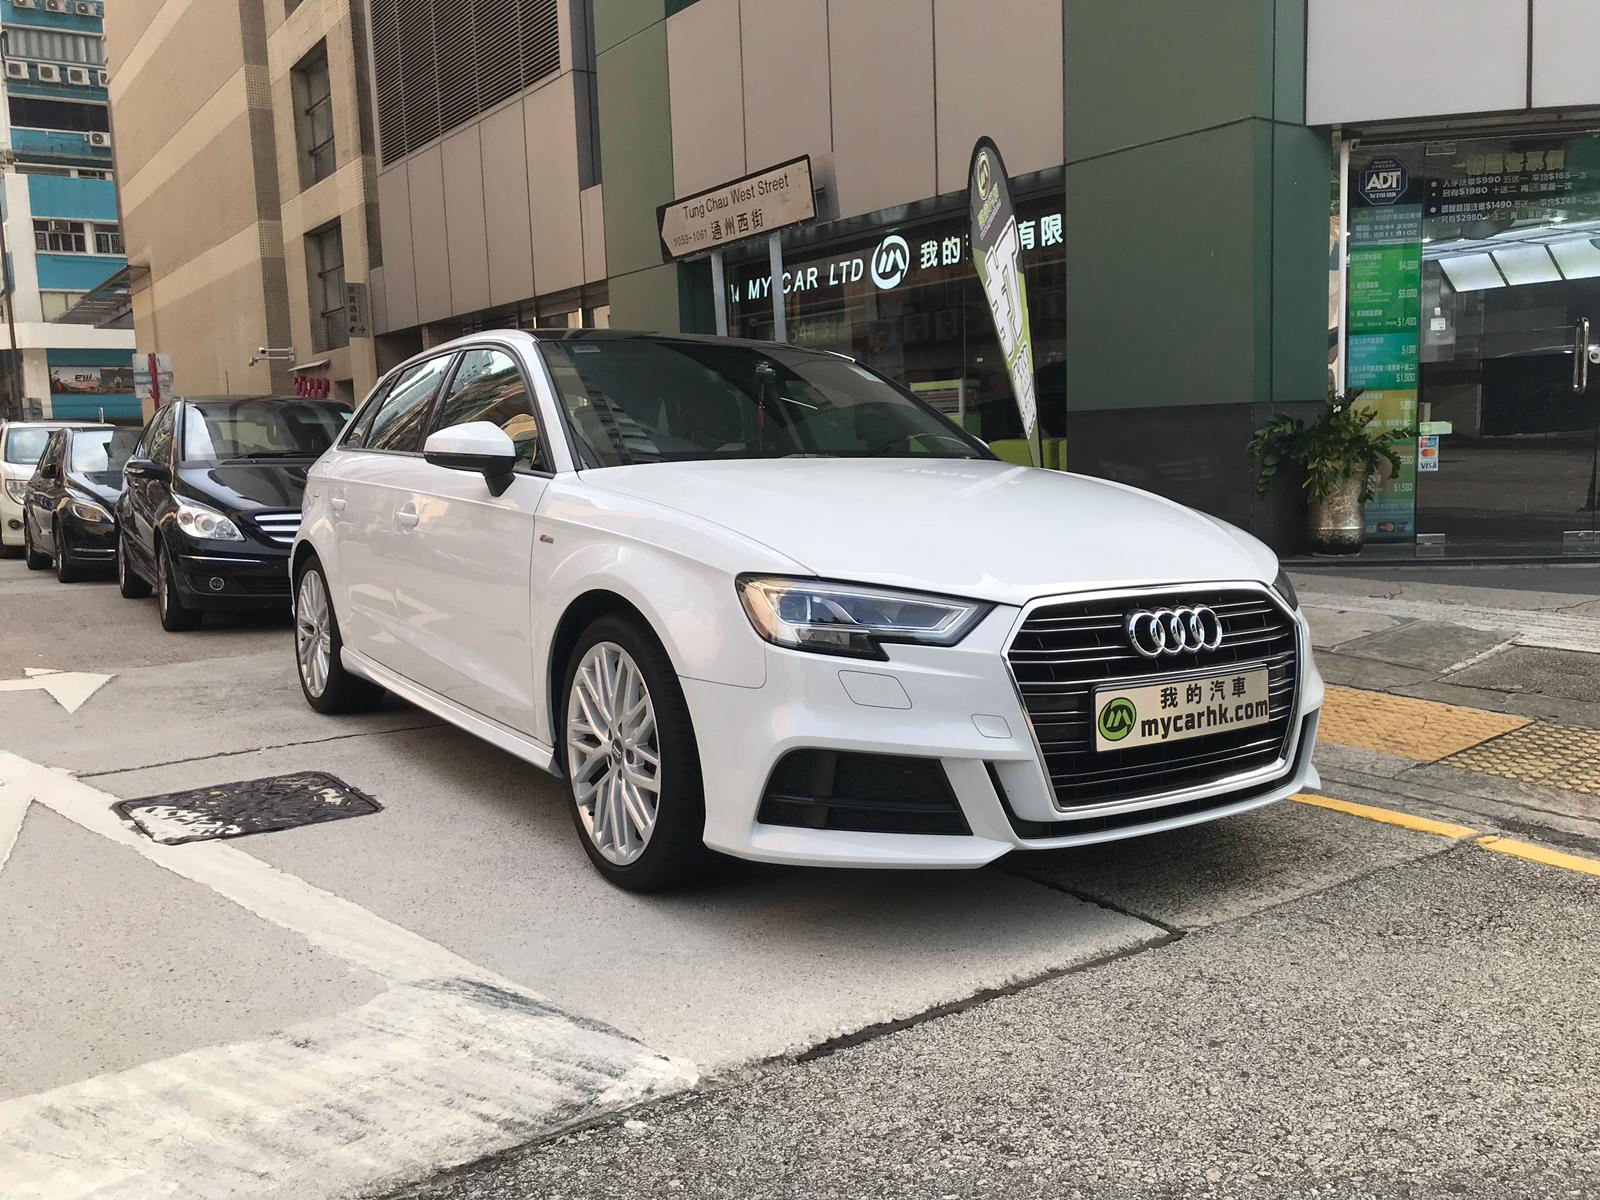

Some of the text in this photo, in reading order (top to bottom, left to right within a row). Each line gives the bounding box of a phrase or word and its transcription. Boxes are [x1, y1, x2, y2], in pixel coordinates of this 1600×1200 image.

[682, 173, 790, 220] Tung Chau West Street
[1365, 171, 1401, 190] ADT
[710, 208, 764, 240] 通州西街
[920, 233, 969, 269] 我的
[748, 275, 773, 300] MY
[782, 267, 818, 294] CAR
[829, 258, 864, 286] LTD
[1160, 677, 1246, 710] 我的汽車
[1141, 699, 1268, 740] mycarhk.com
